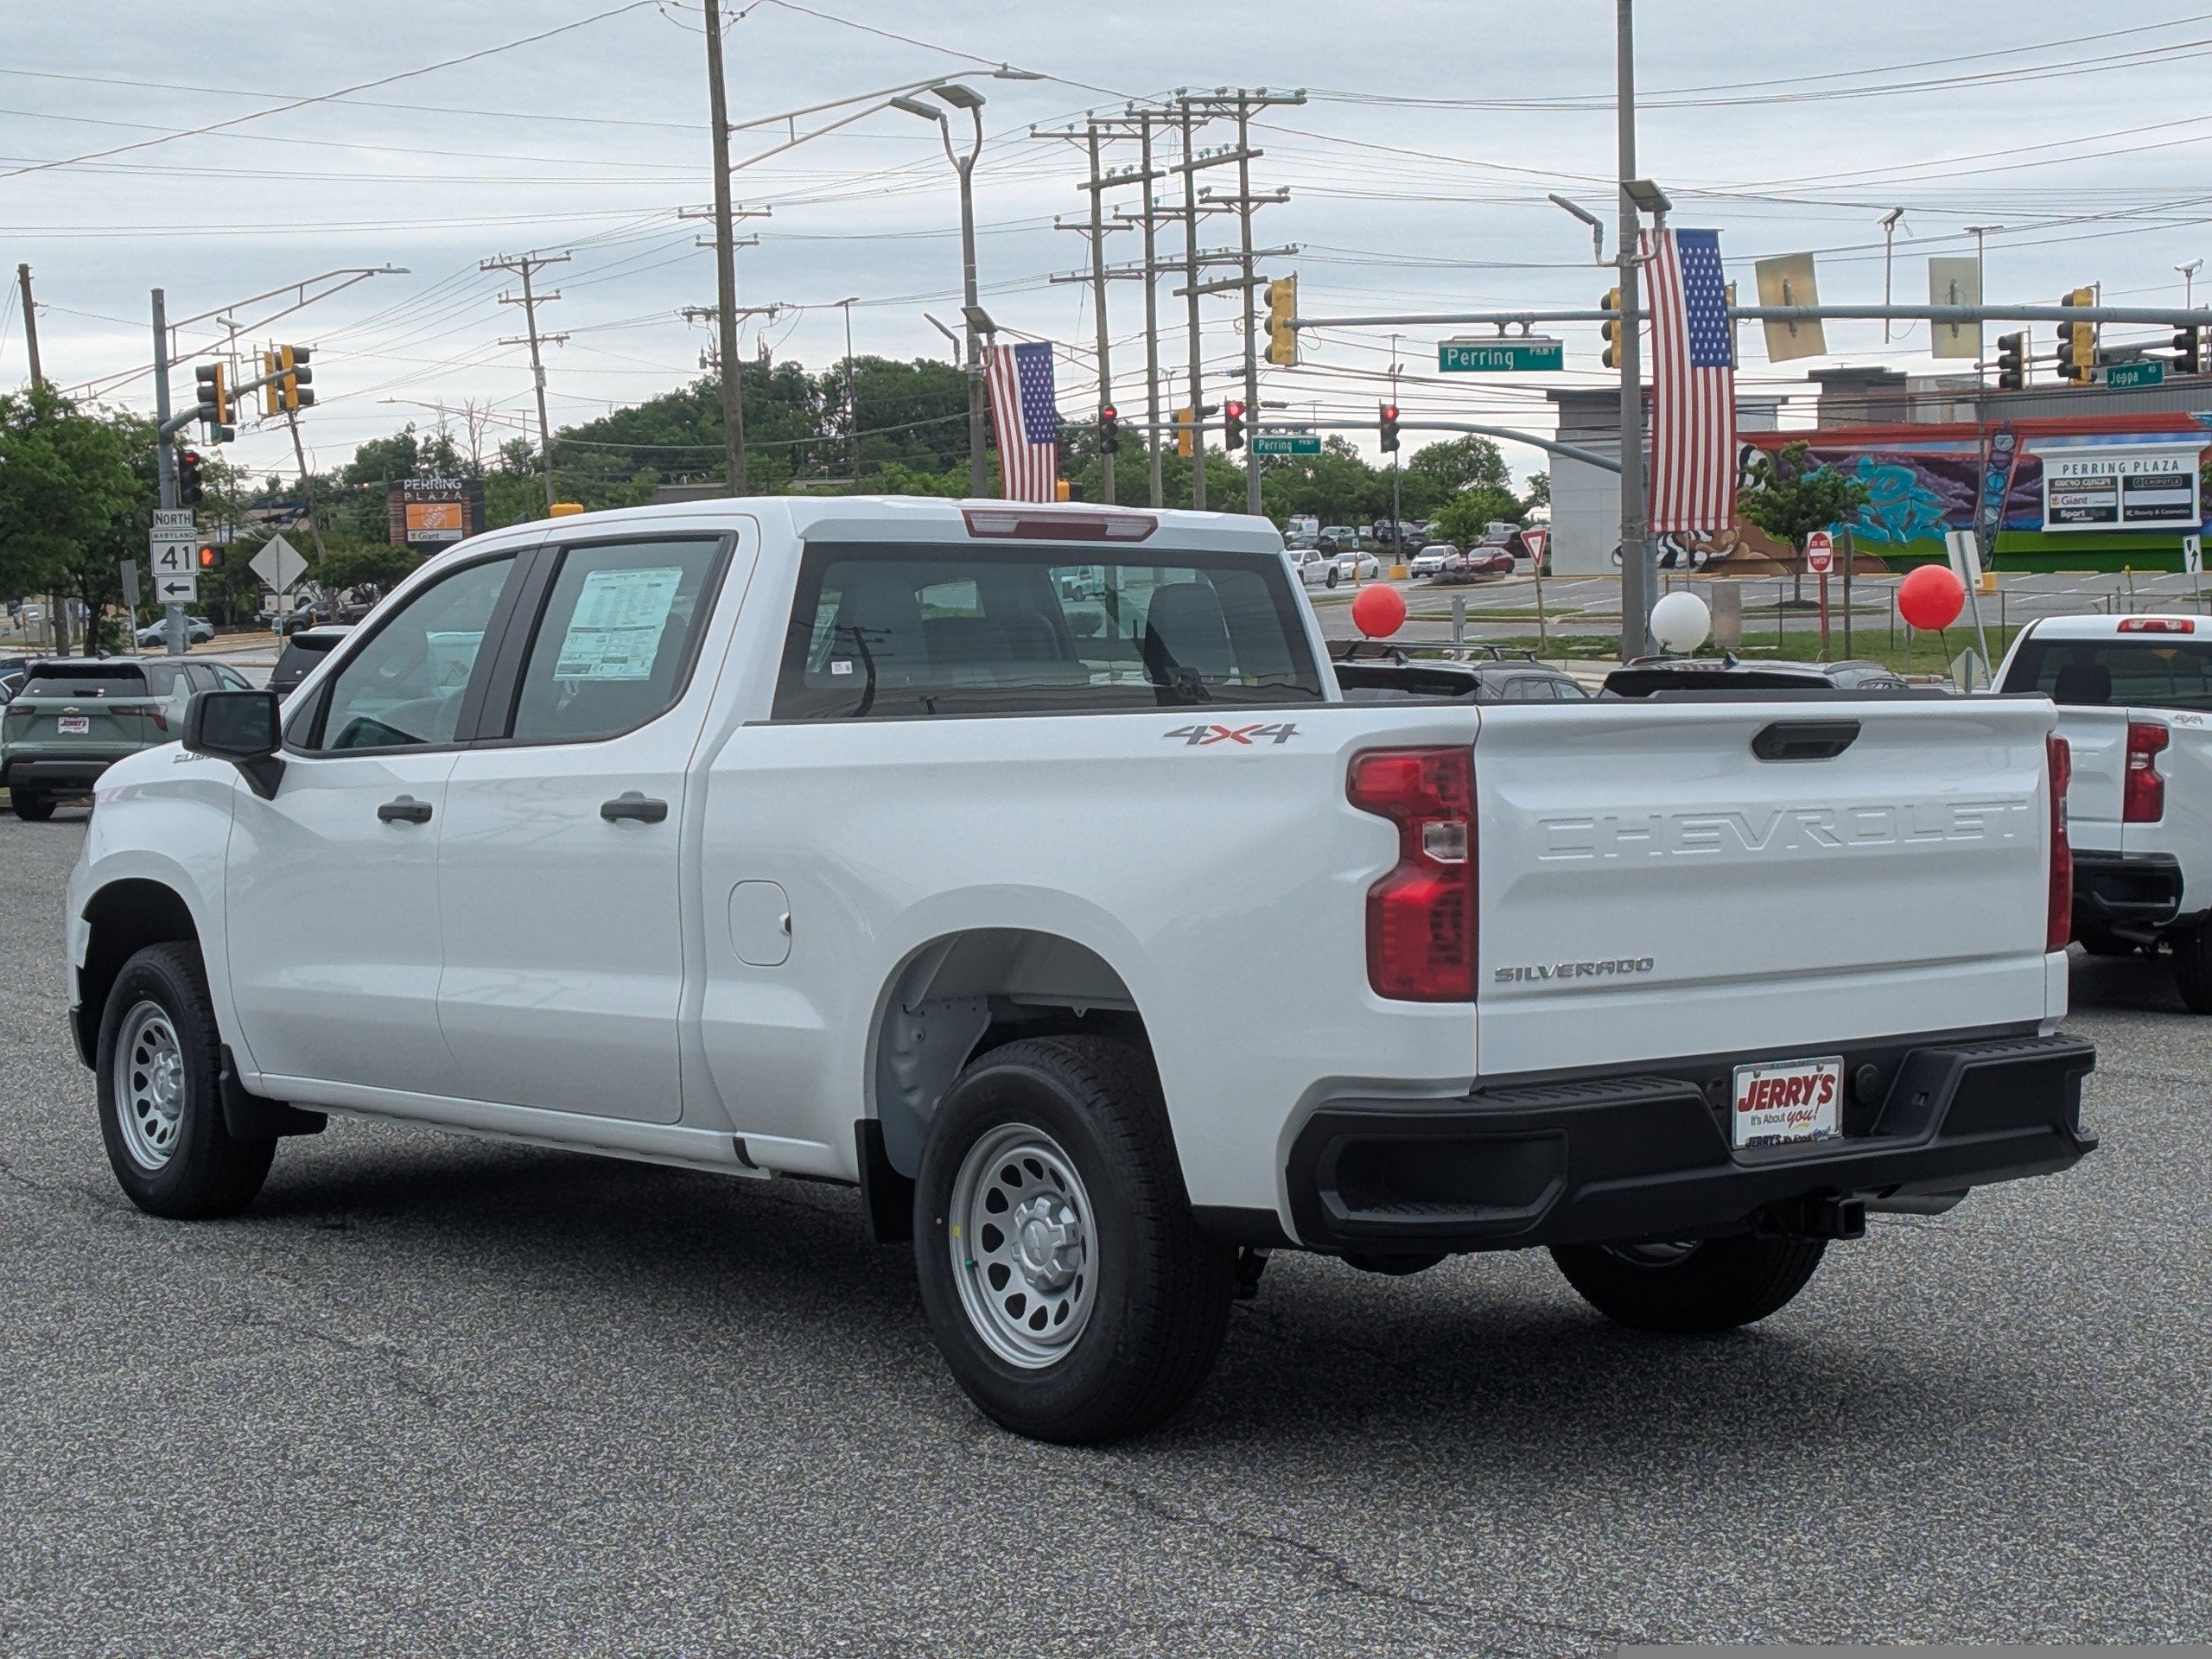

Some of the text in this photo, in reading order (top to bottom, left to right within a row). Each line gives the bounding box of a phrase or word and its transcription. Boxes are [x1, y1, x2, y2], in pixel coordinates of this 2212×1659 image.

[1447, 346, 1556, 369] Perring PKWY
[1258, 439, 1293, 453] Perring
[2063, 460, 2179, 474] PERRING PLAZA
[404, 478, 462, 490] PERRING
[404, 491, 462, 501] PLAZA
[2061, 495, 2088, 505] Giant
[156, 512, 191, 525] NORTH
[160, 545, 190, 570] 41
[1537, 799, 2029, 861] CHEVROLET
[1494, 957, 1655, 983] SILVERADO
[1738, 1073, 1836, 1112] JERRY'S
[1751, 1116, 1762, 1126] It's
[1763, 1113, 1786, 1124] About
